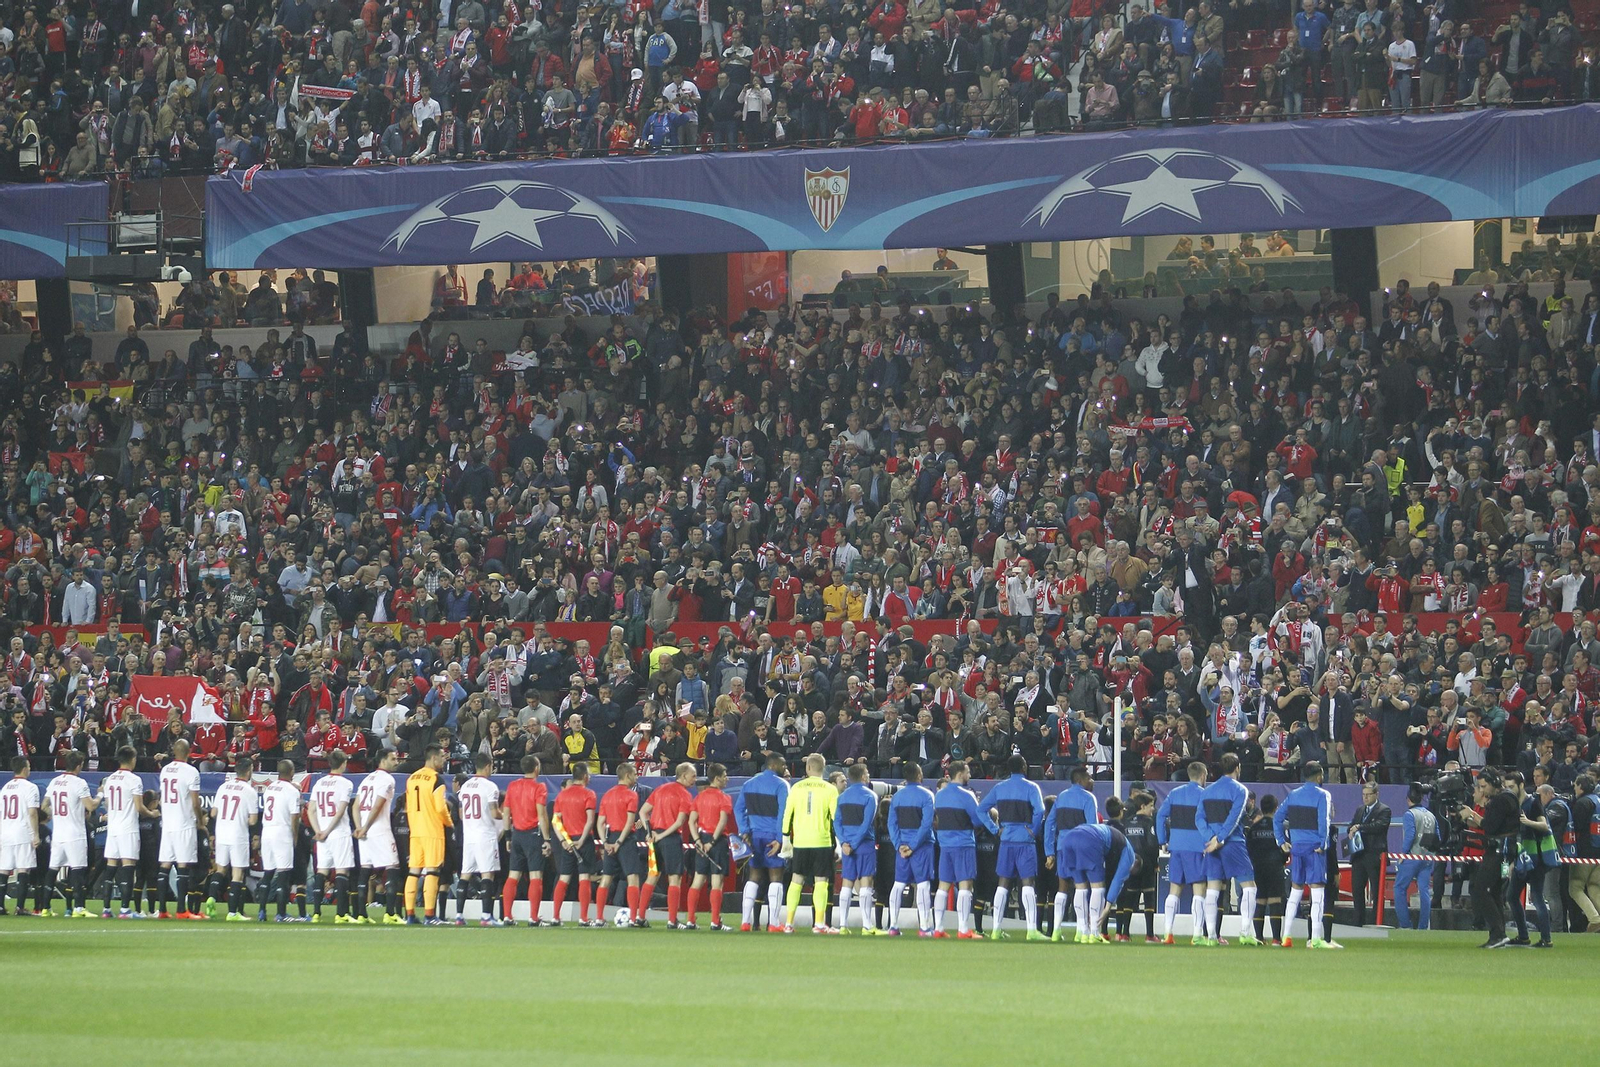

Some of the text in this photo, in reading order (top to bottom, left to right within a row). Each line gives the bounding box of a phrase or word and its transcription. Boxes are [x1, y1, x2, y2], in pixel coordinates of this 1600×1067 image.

[649, 38, 665, 47] GAP
[52, 790, 69, 816] 16
[109, 785, 123, 811] 11
[163, 778, 179, 804] 15
[316, 791, 337, 817] 45
[360, 785, 375, 812] 23
[414, 785, 421, 812] 1
[807, 791, 813, 815] 1
[3, 794, 19, 820] 10
[221, 794, 241, 820] 17
[264, 795, 275, 821] 3
[462, 793, 482, 820] 20
